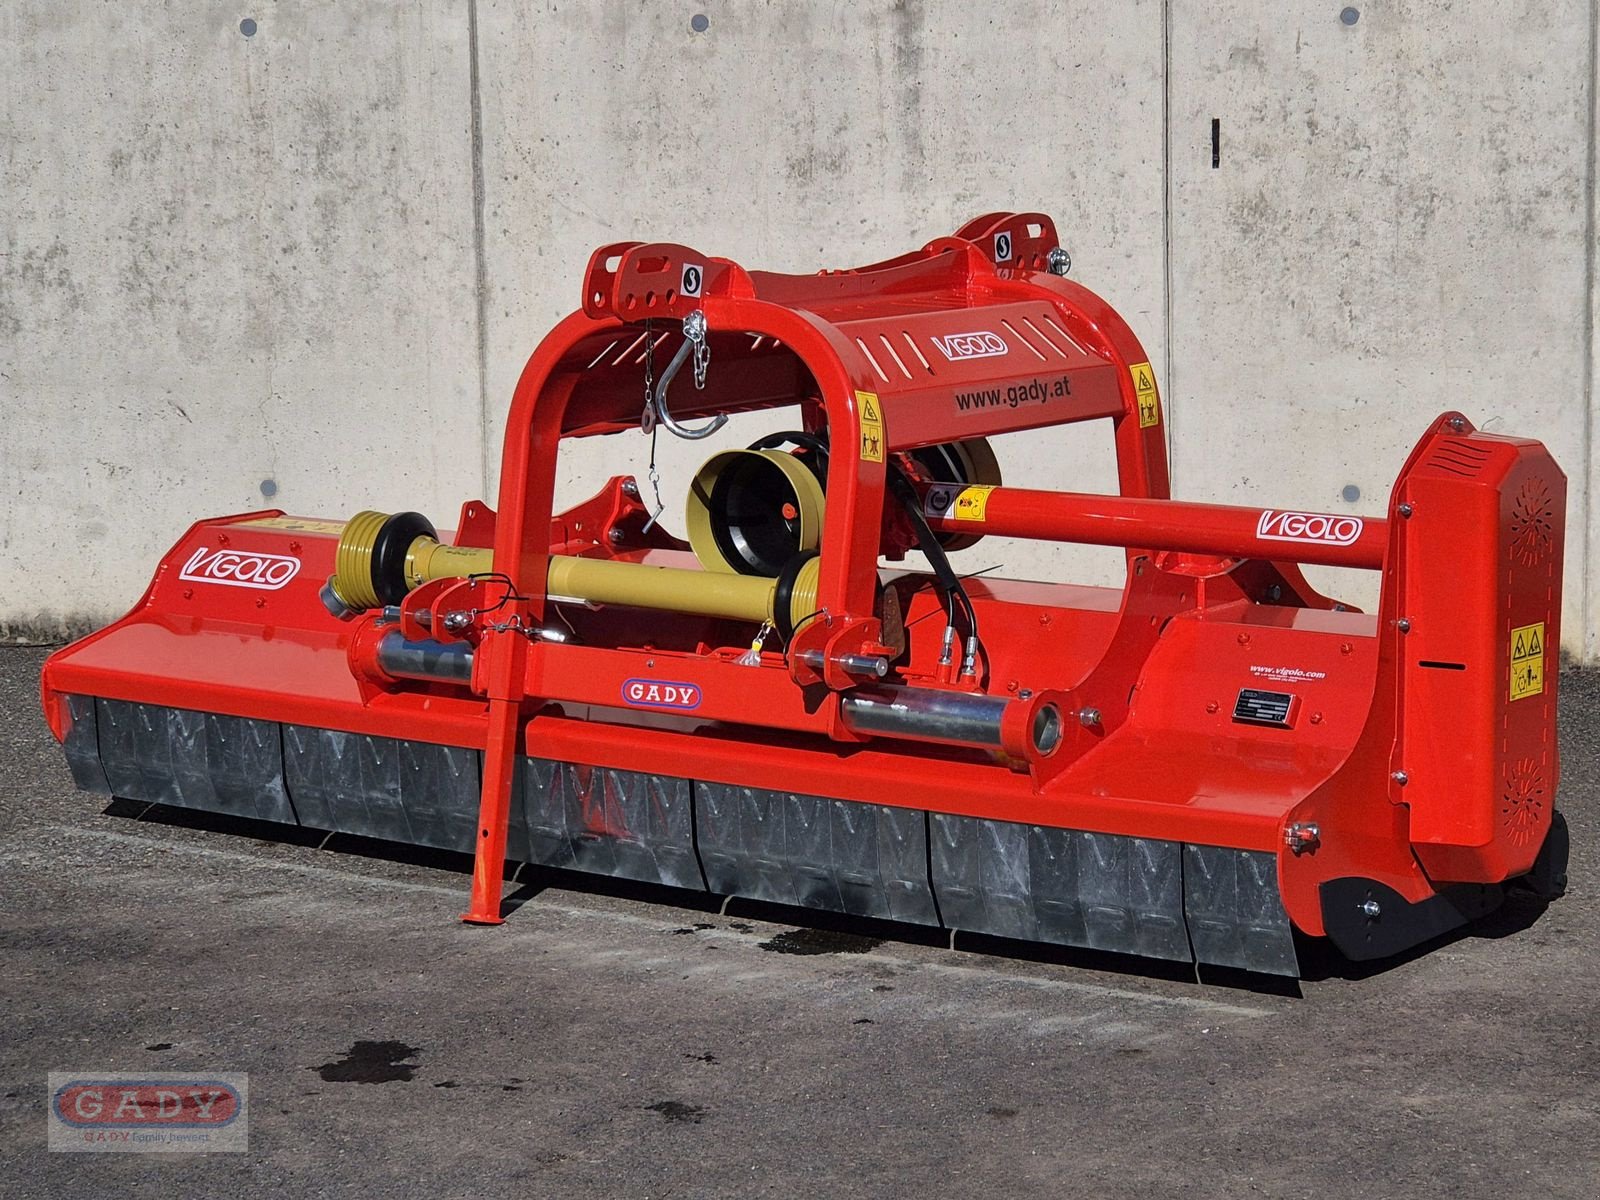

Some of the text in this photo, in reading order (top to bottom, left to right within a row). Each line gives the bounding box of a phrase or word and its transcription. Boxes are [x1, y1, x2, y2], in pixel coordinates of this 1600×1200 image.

[930, 331, 1008, 361] VIGOLO
[955, 376, 1071, 410] www.gady.at
[1256, 510, 1363, 546] VIGOLO
[179, 547, 301, 590] VIGOLO
[1250, 665, 1326, 679] www.vigolo.com
[630, 684, 694, 704] GADY
